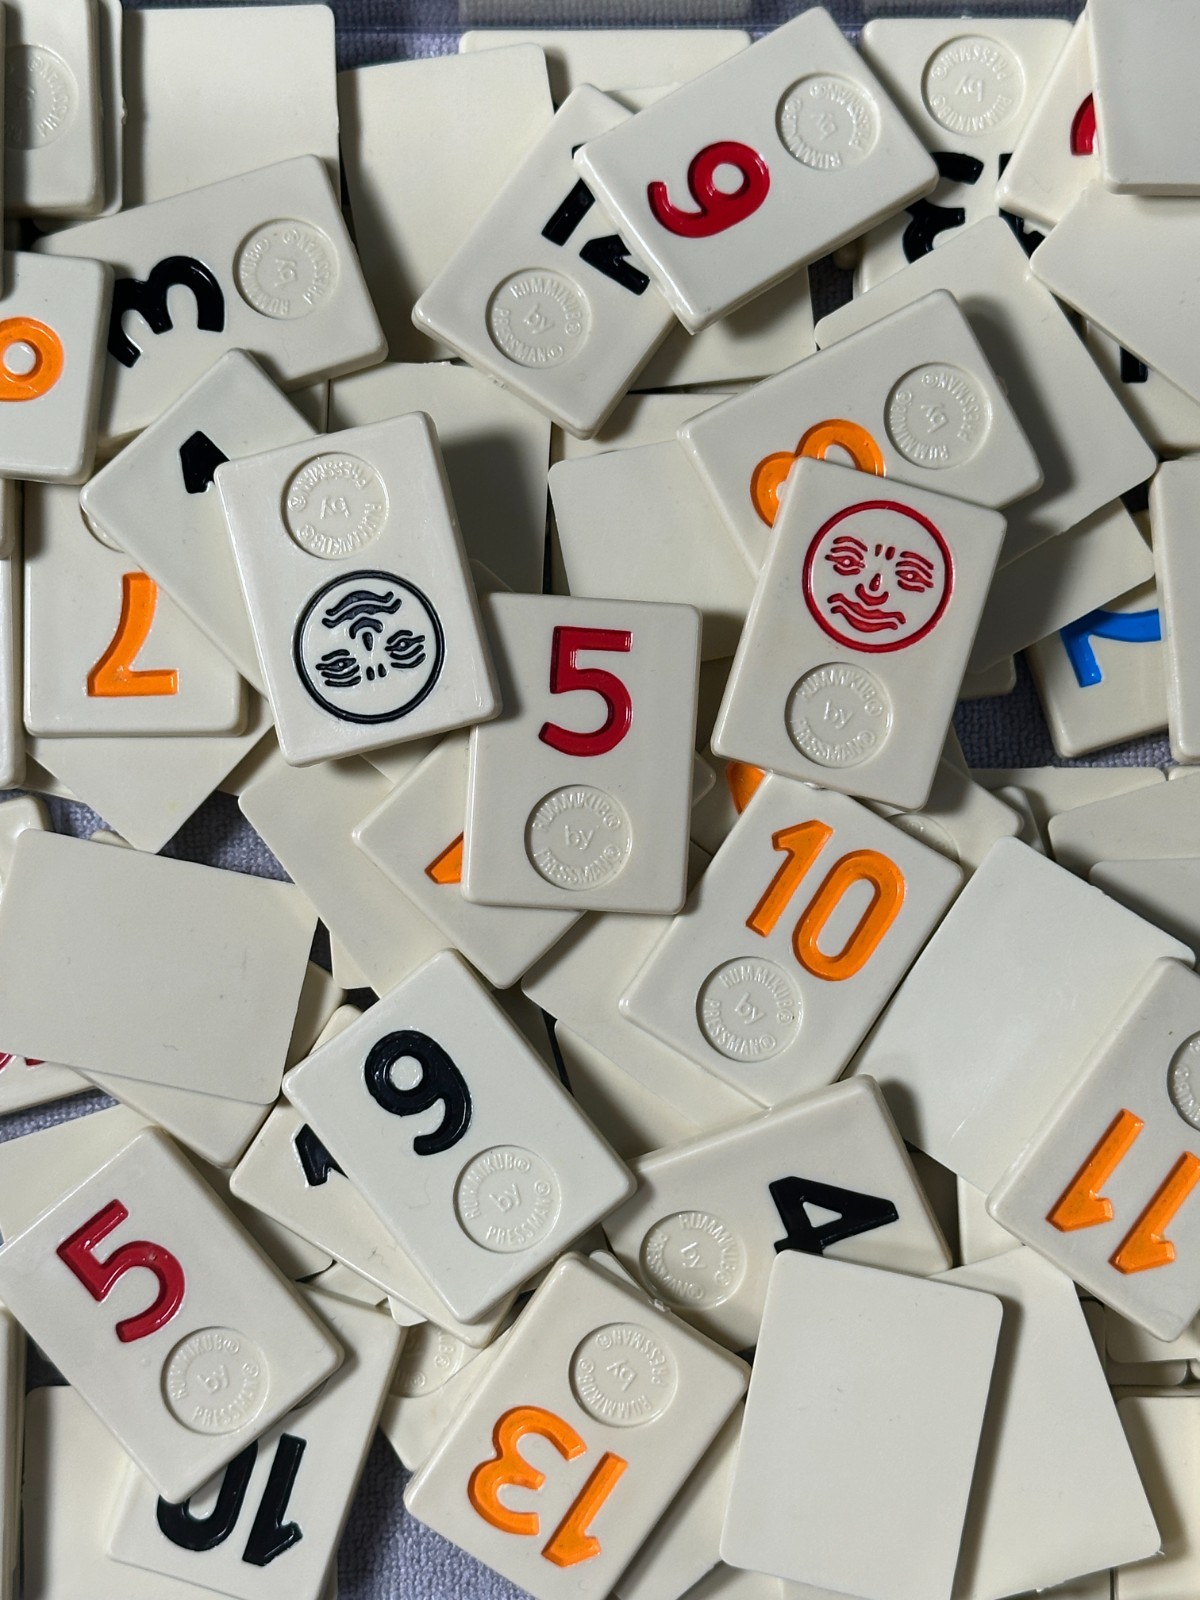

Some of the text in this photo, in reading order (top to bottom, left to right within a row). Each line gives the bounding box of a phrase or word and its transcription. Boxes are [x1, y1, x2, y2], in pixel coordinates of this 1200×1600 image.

[955, 75, 982, 102] by
[107, 256, 225, 376] 3
[524, 303, 555, 334] by
[920, 403, 949, 433] by
[87, 572, 178, 697] 7
[538, 626, 633, 757] 5
[823, 699, 855, 729] by
[564, 825, 594, 851] by
[746, 820, 907, 981] 10
[734, 992, 767, 1025] by
[364, 1030, 472, 1156] 9
[488, 1183, 522, 1213] by
[1047, 1109, 1200, 1274] 11
[769, 1176, 899, 1257] 4
[57, 1200, 185, 1343] 5
[681, 1241, 707, 1269] by
[197, 1364, 230, 1394] by
[606, 1359, 638, 1392] by
[467, 1405, 628, 1568] 13
